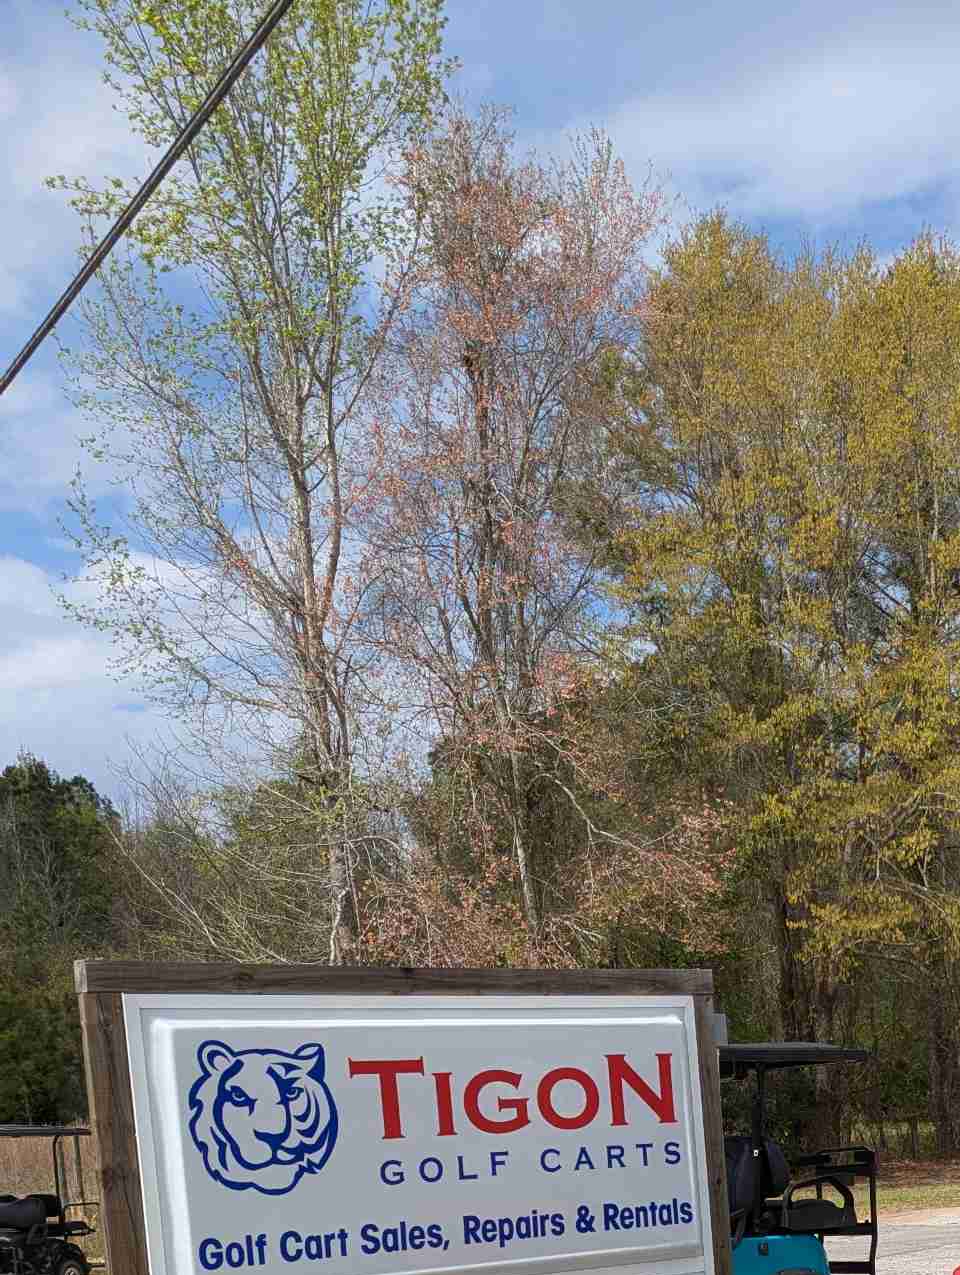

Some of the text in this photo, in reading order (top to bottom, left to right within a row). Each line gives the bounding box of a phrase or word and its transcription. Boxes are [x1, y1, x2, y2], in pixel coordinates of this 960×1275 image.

[348, 1053, 680, 1140] TIGON
[379, 1142, 682, 1186] GOLF CARTS
[198, 1198, 694, 1271] Golf Cart Sales, Repairs & Rentals
